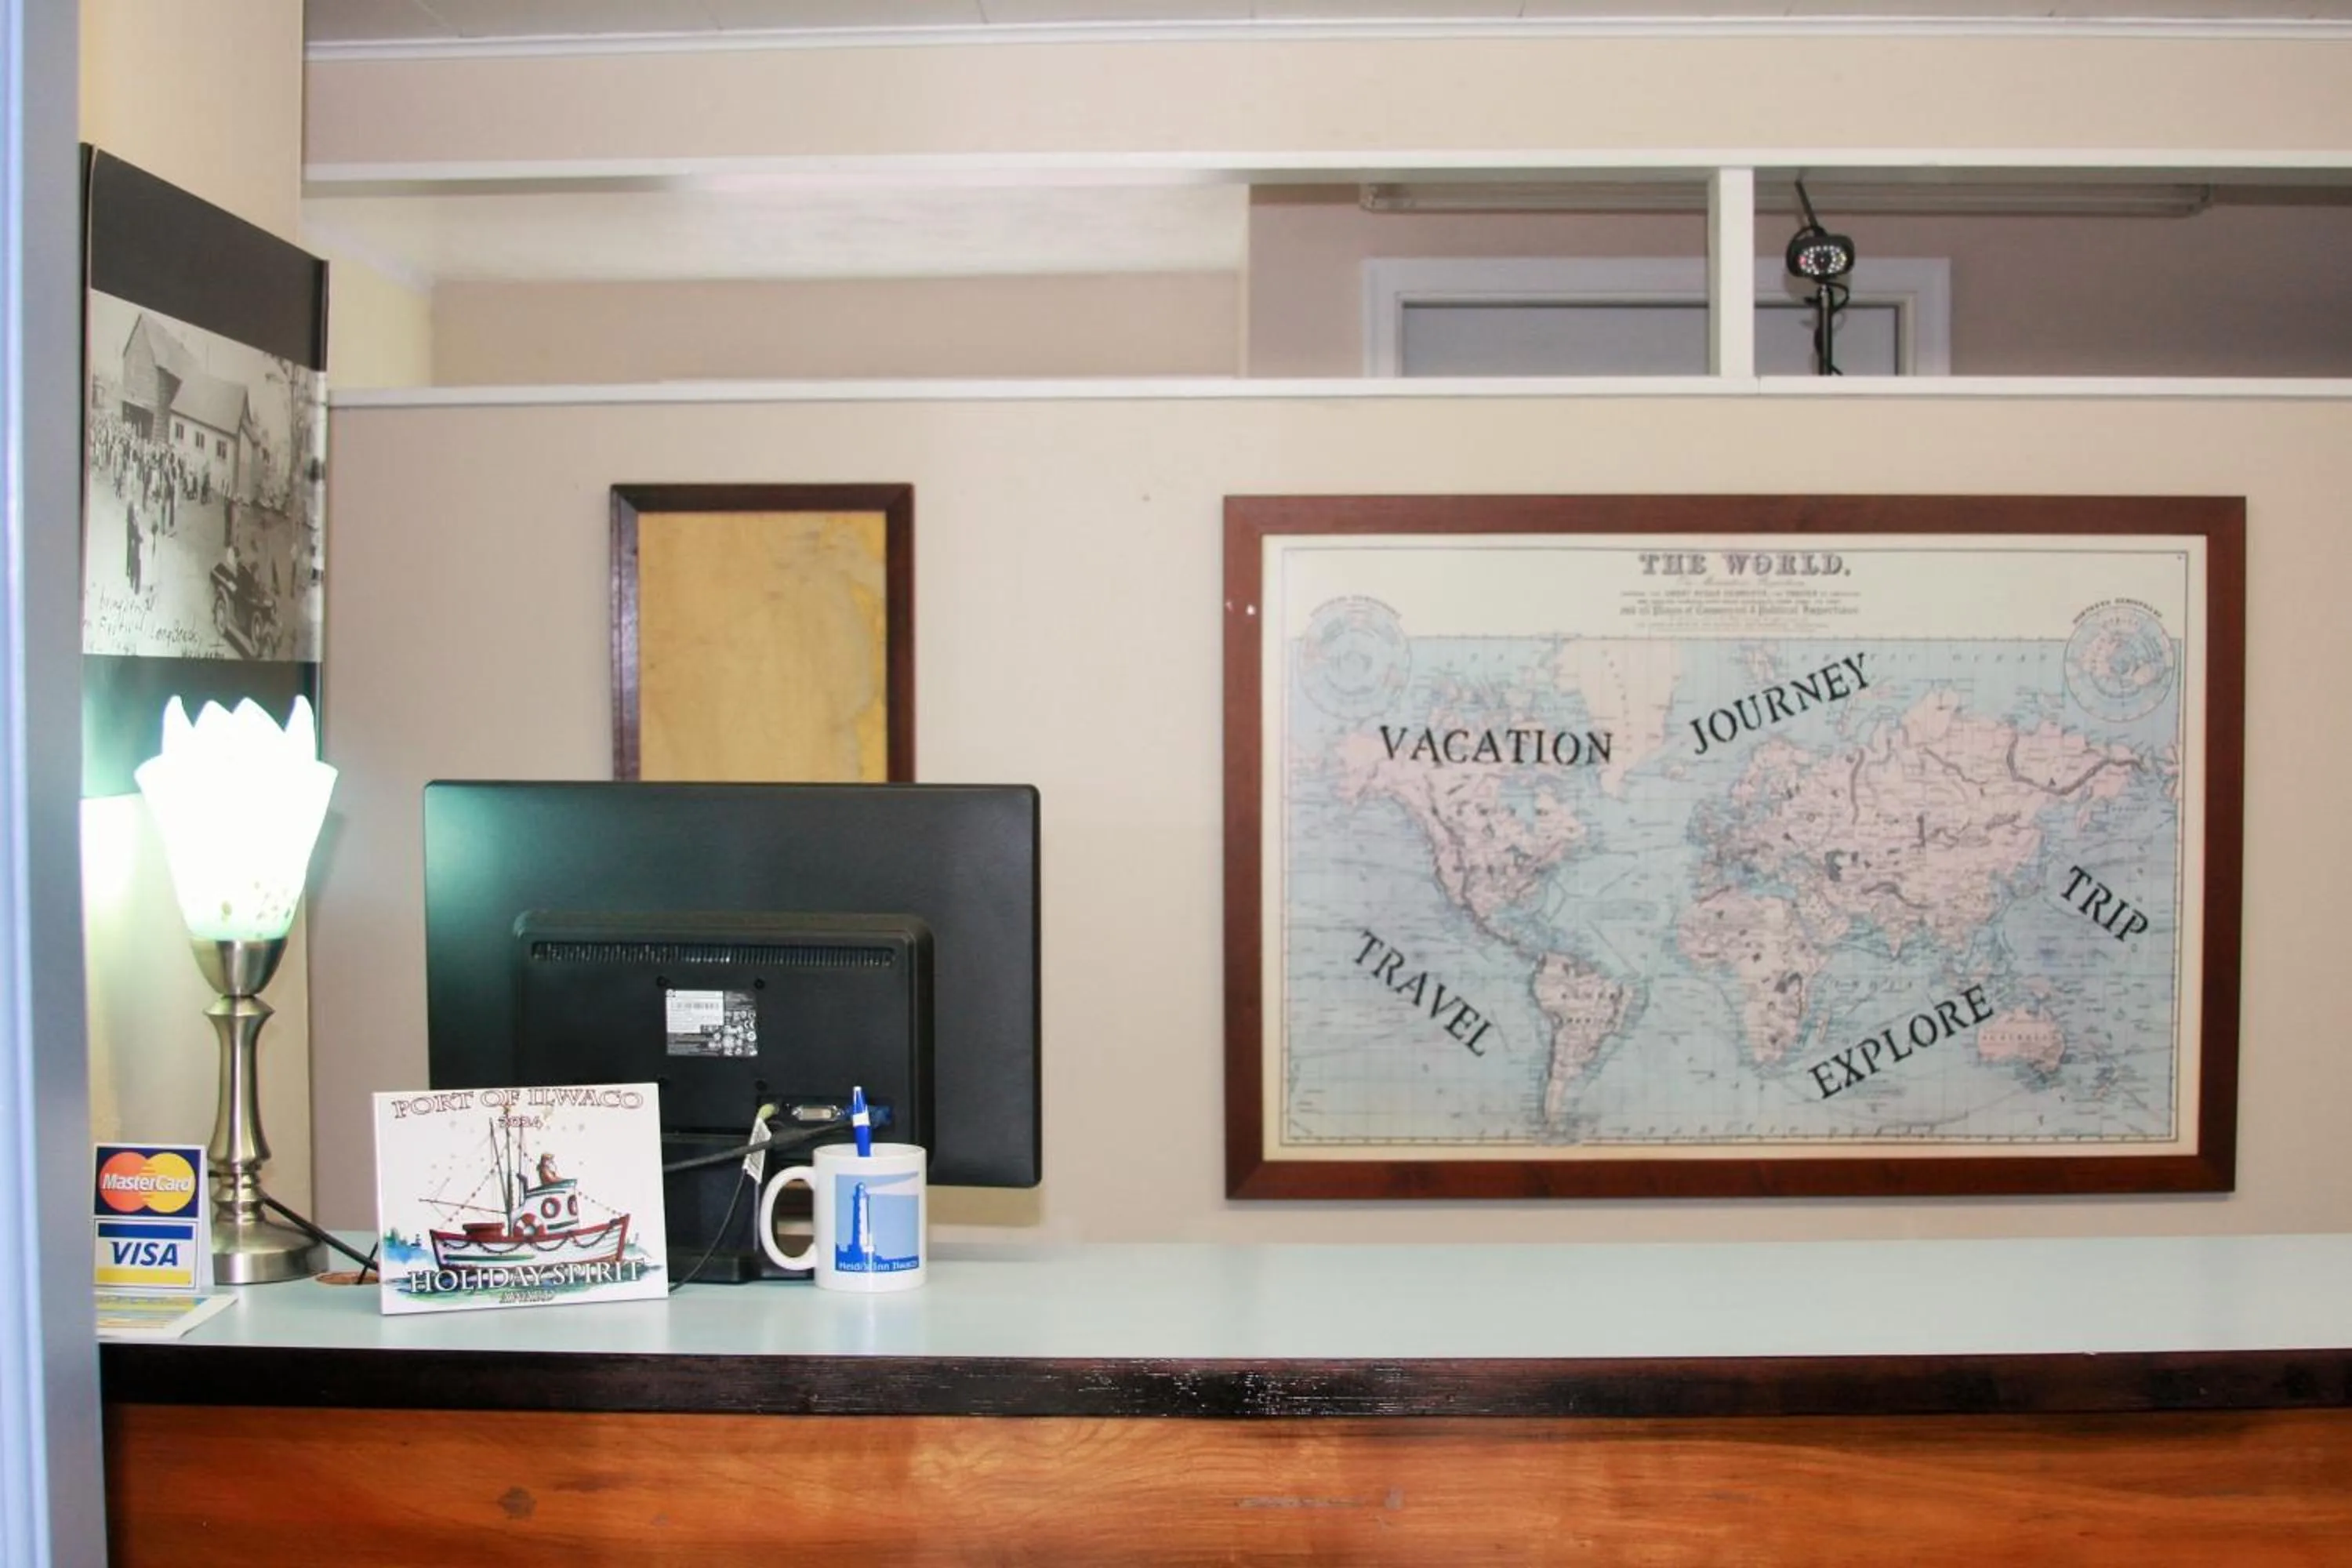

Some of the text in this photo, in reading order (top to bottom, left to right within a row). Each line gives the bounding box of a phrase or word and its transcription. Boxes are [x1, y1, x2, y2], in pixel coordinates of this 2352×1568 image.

[1638, 553, 1851, 577] THE WORLD.
[1689, 652, 1871, 756] JOURNEY
[1379, 724, 1613, 767] VACATION
[2060, 865, 2150, 943] TRIP
[1354, 930, 1496, 1058] TRAVEL
[1807, 984, 1995, 1099] EXPLORE
[391, 1088, 644, 1119] PORT OF ILWACO
[102, 1172, 191, 1192] MasterCard
[111, 1241, 179, 1267] VISA
[407, 1259, 646, 1293] HOLIDAY SPIRIT
